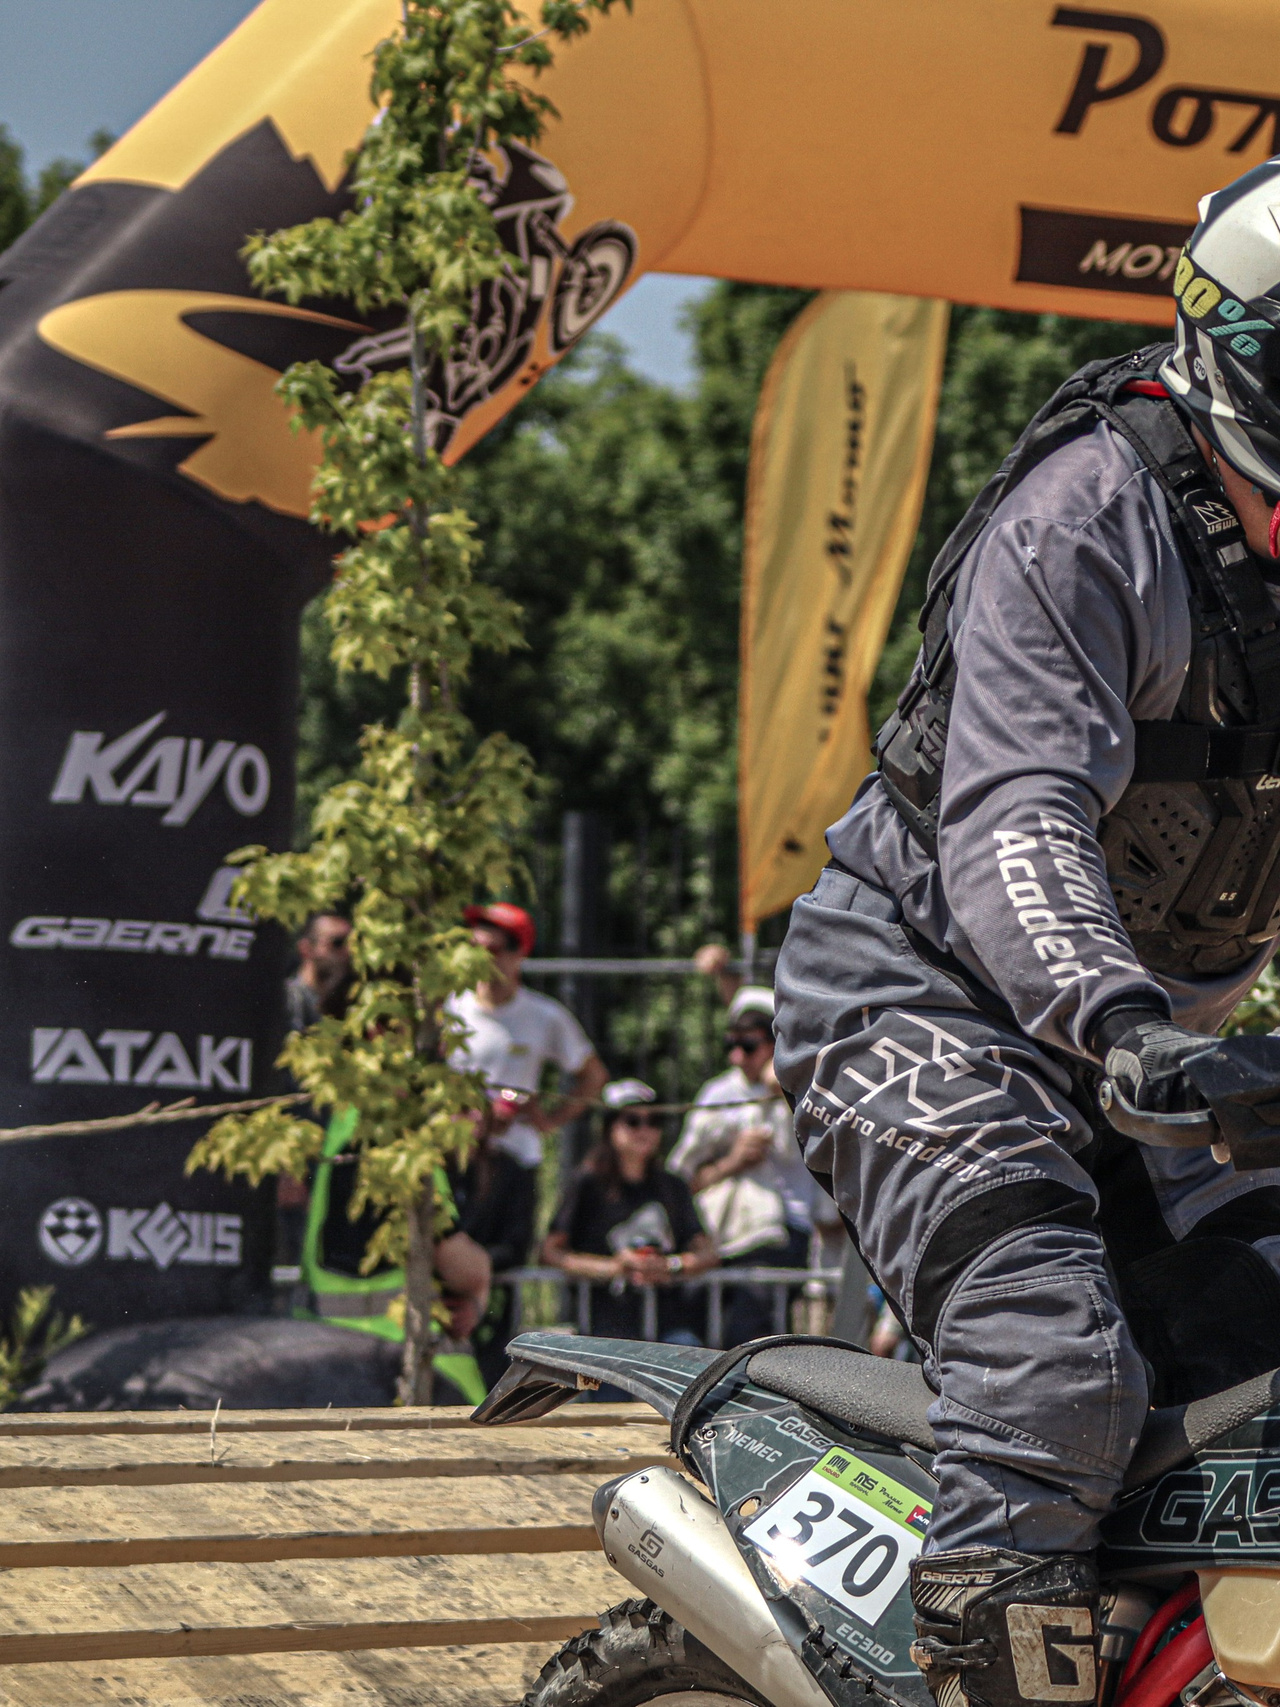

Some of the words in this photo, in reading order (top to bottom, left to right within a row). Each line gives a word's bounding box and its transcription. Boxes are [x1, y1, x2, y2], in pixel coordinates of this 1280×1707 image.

[1174, 245, 1275, 357] 00%
[1194, 359, 1206, 377] 370
[32, 1027, 253, 1093] ATAKI
[836, 1106, 877, 1136] Pro
[876, 1125, 993, 1183] Academy
[724, 1429, 783, 1463] NEMEC
[822, 1465, 841, 1479] ENDURO
[627, 1543, 665, 1578] GASGAS
[767, 1491, 900, 1597] 370
[836, 1623, 896, 1666] EC300
